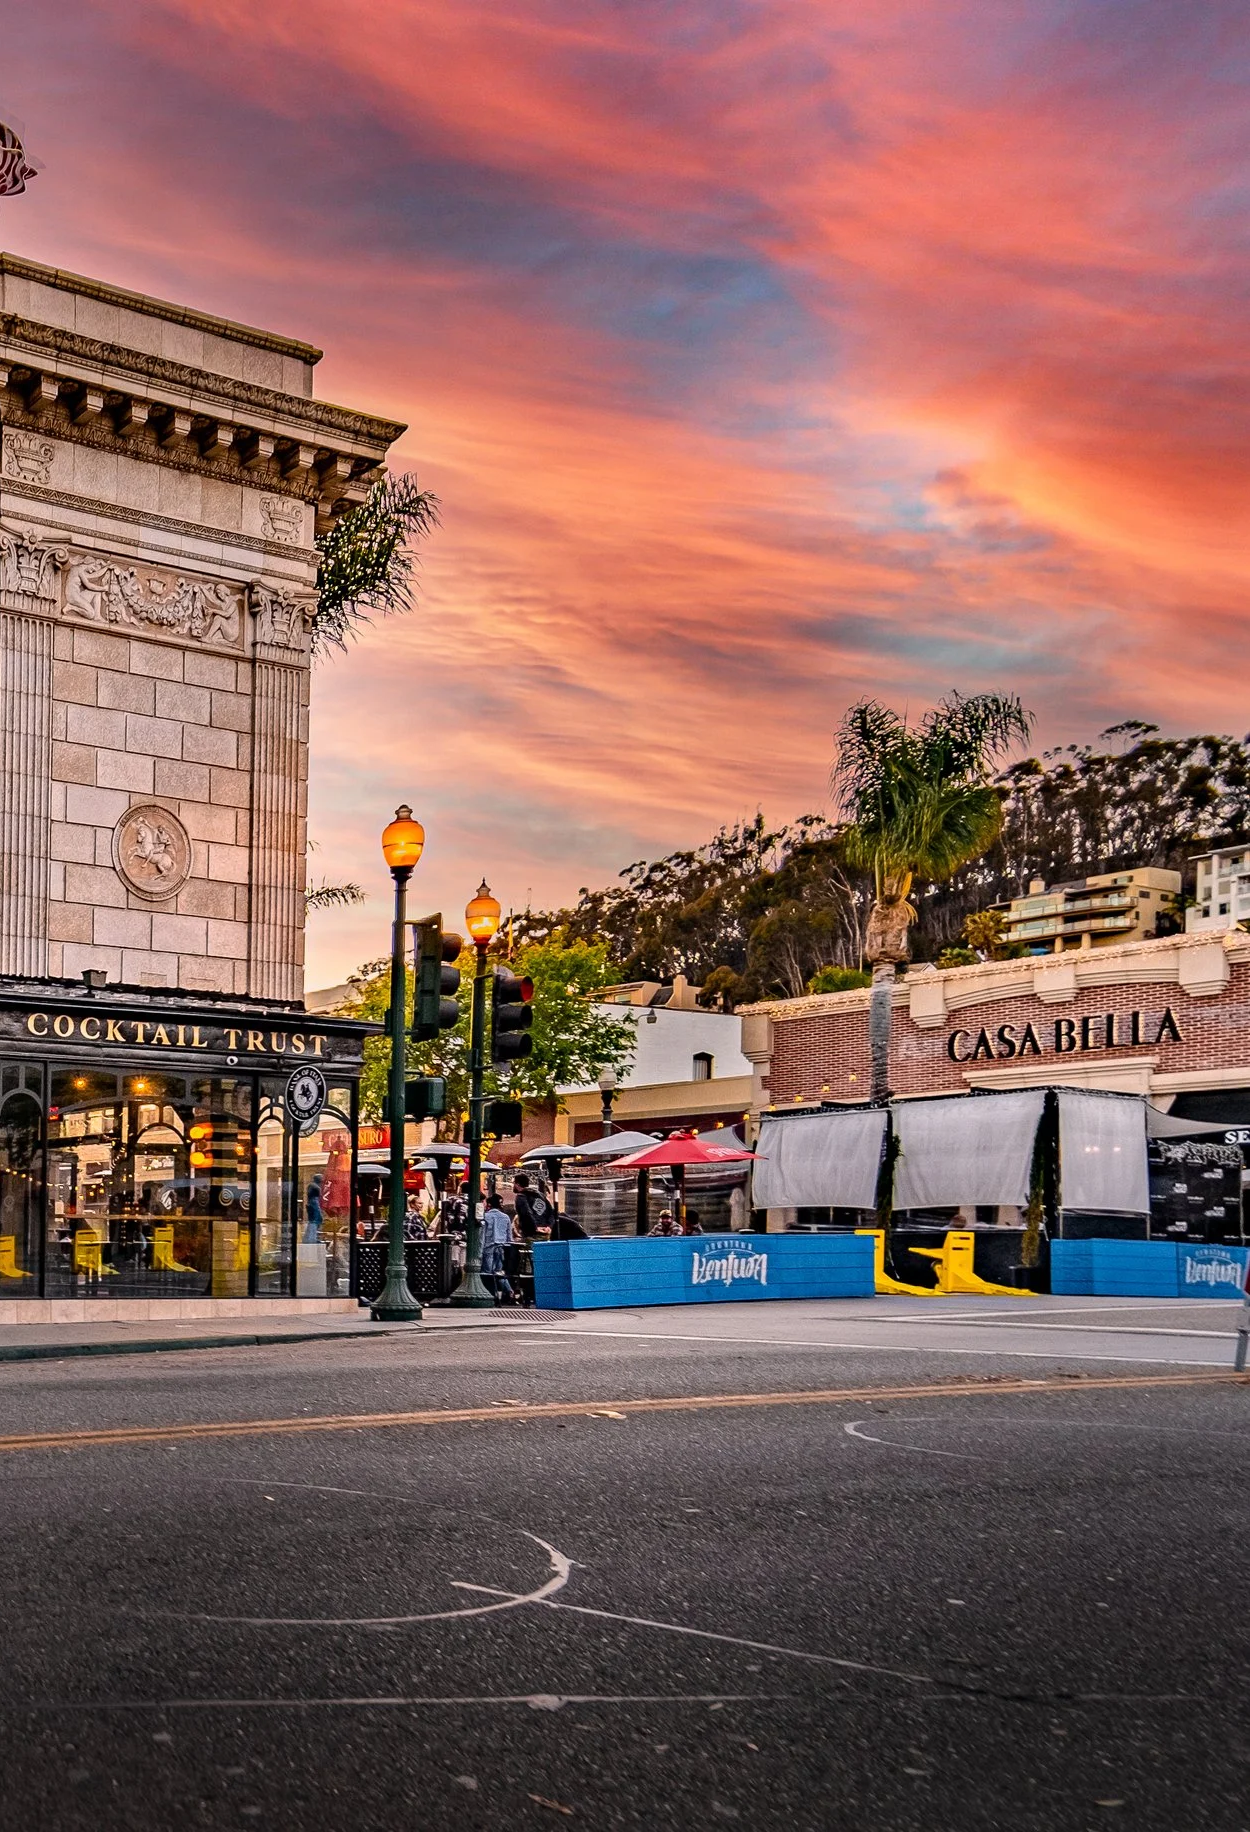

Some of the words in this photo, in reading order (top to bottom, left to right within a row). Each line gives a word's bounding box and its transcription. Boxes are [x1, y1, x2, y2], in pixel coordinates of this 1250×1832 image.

[27, 1012, 209, 1049] COCKTAIL
[224, 1028, 329, 1057] TRUST
[947, 1022, 1042, 1063] CASA
[1054, 1007, 1183, 1053] BELLA
